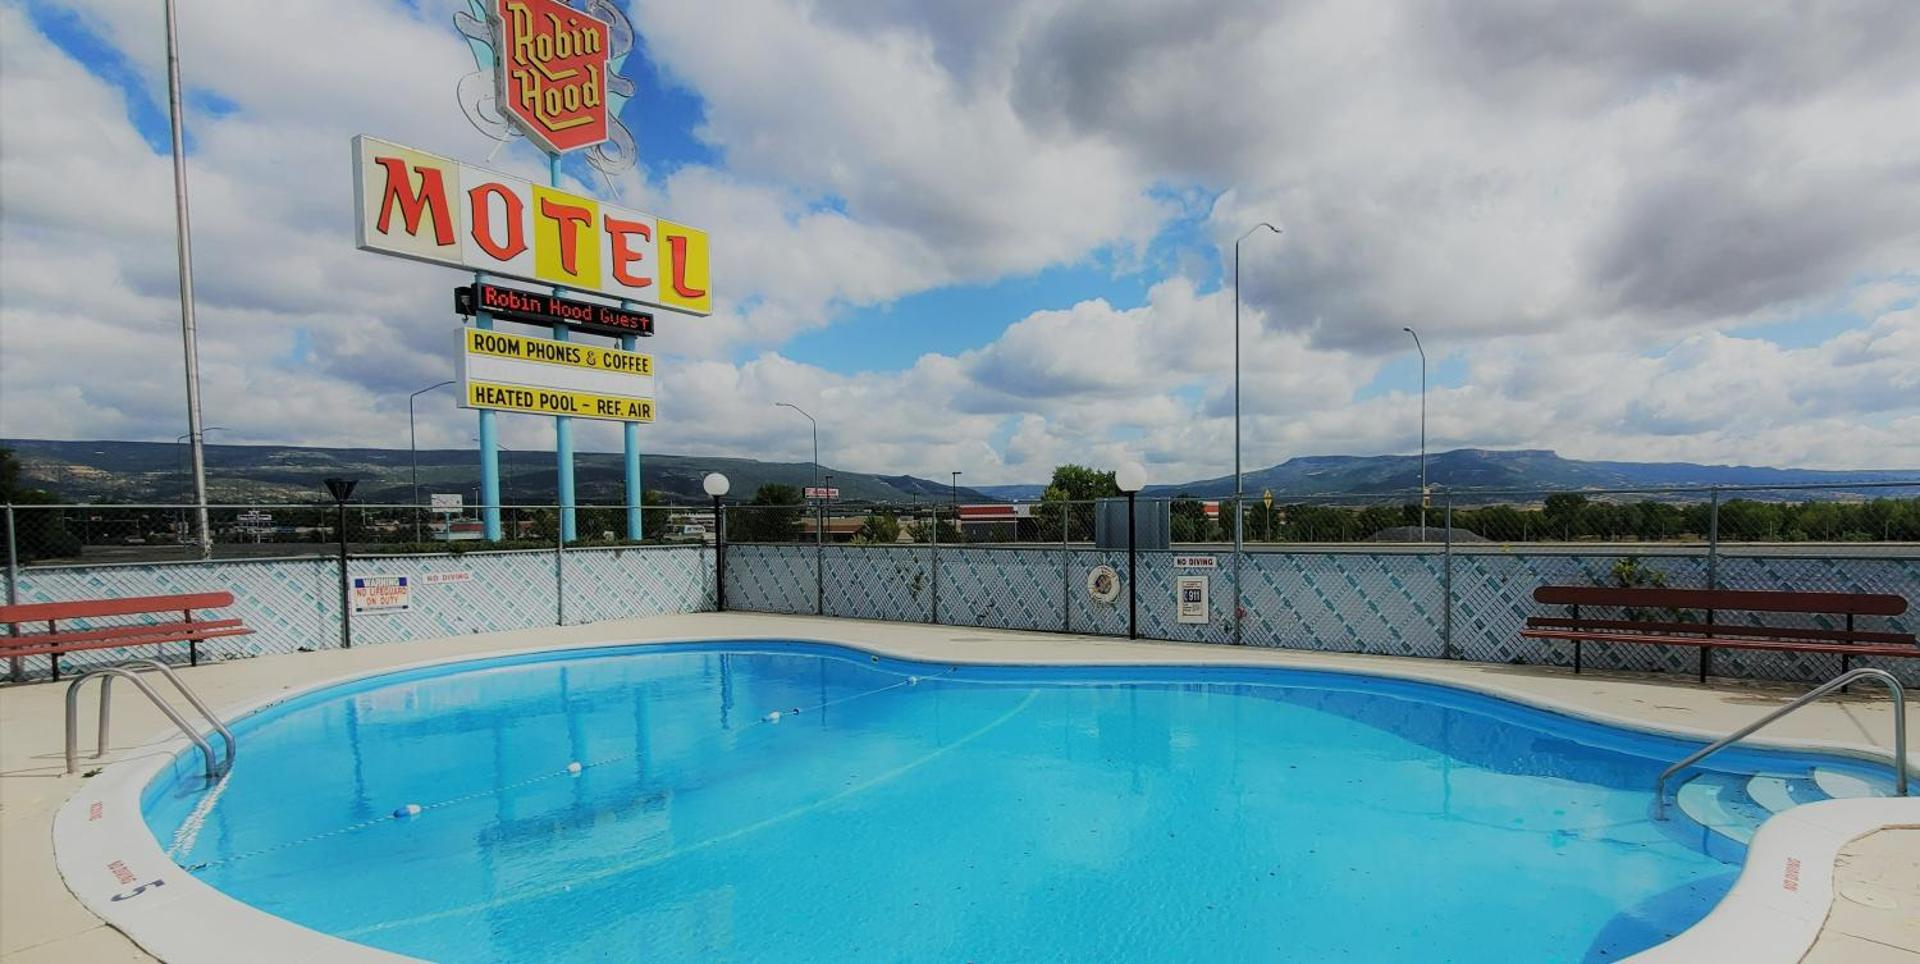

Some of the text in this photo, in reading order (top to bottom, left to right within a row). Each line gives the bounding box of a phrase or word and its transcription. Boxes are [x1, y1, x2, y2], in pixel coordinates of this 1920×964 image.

[506, 1, 601, 81] Robin
[512, 64, 600, 131] Hood
[375, 156, 706, 298] MOTEL
[484, 285, 650, 330] Robin Hood Guest
[474, 334, 649, 373] ROOM PHONES & COFFEE
[475, 386, 533, 408] HEATED
[539, 392, 578, 412] POOL
[597, 399, 624, 416] REF.
[628, 402, 651, 418] AIR
[442, 573, 469, 581] DIVING
[1177, 558, 1213, 566] NO DIVING
[356, 588, 367, 597] NO
[380, 596, 399, 605] DUTY
[110, 879, 165, 902] 5
